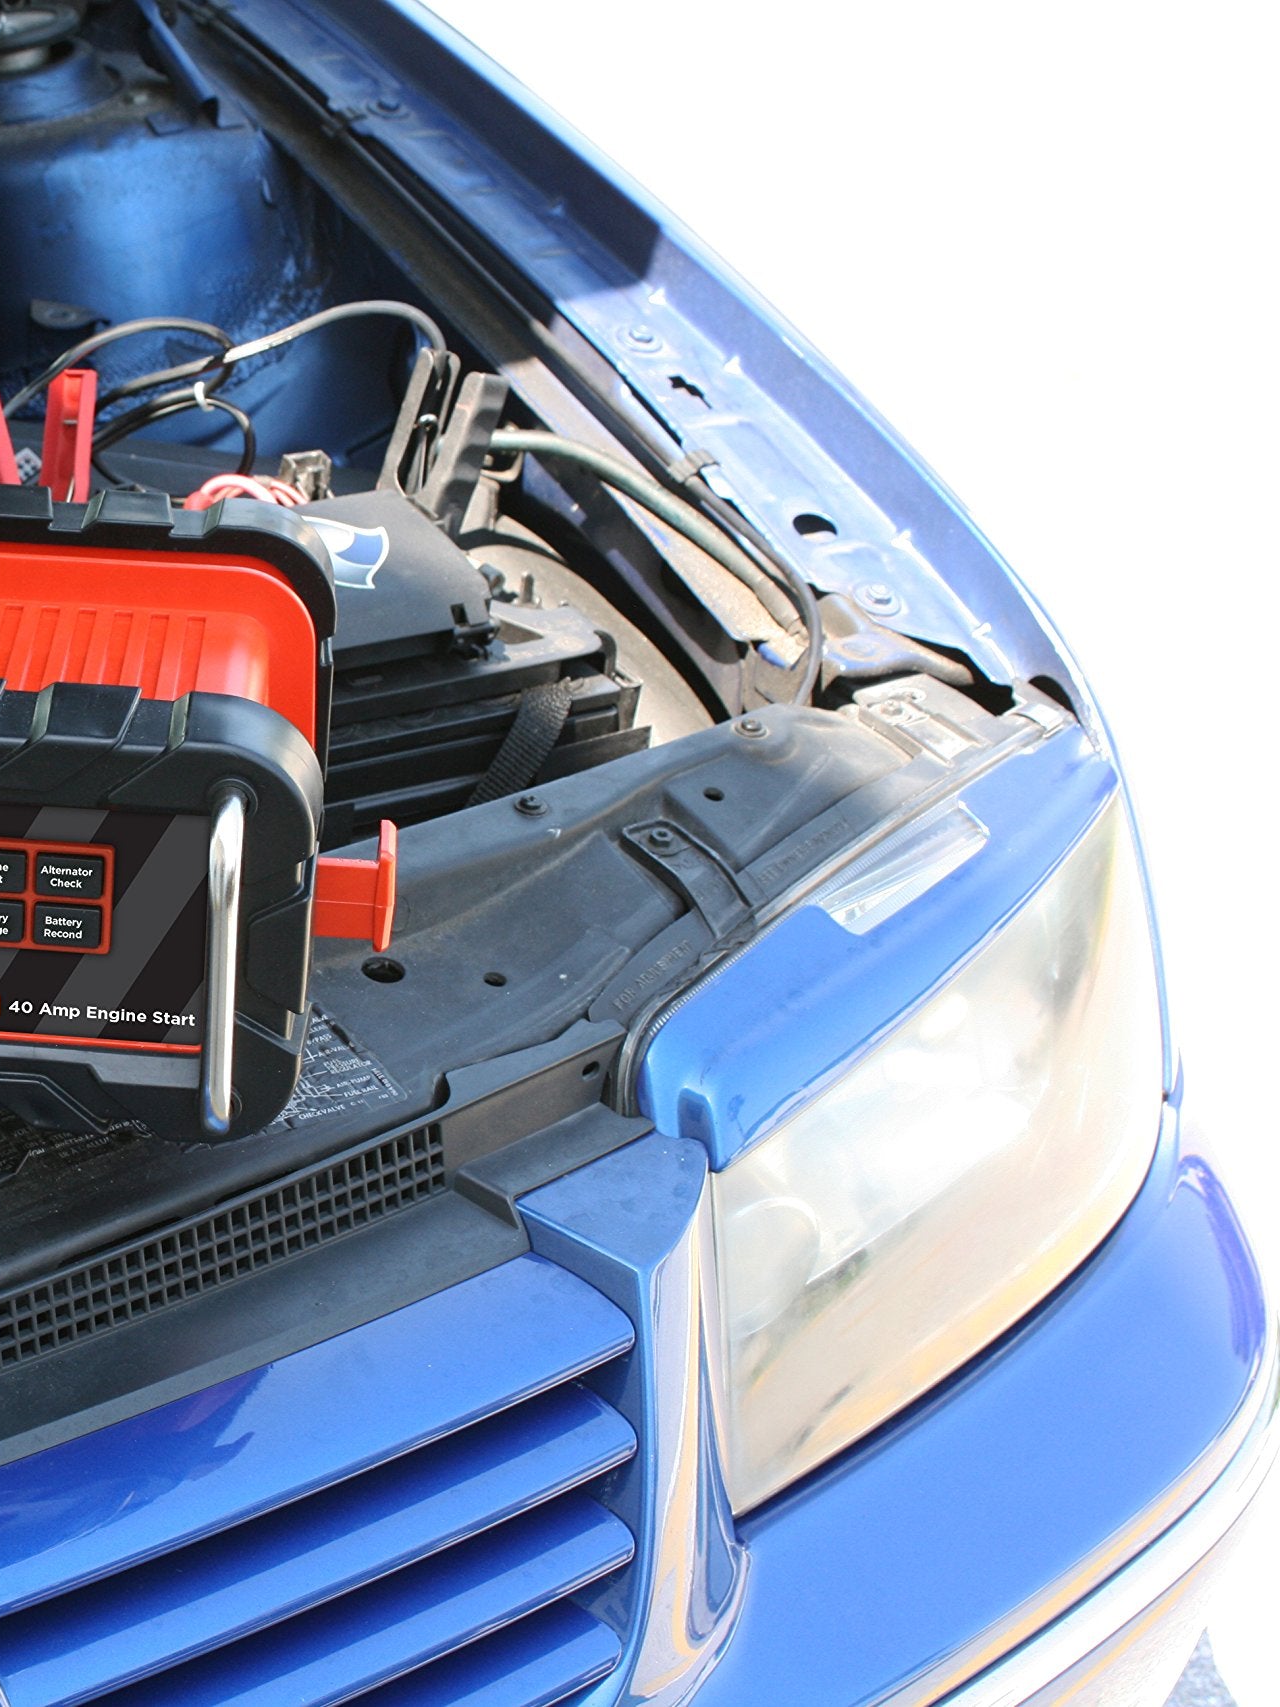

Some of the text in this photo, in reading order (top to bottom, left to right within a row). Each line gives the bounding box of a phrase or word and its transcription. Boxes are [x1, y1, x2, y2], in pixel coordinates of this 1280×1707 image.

[41, 865, 93, 878] Alternator
[50, 878, 82, 889] Check
[45, 916, 82, 929] Battery
[44, 928, 82, 939] Recond
[8, 1000, 196, 1027] 40 Amp Engine Start
